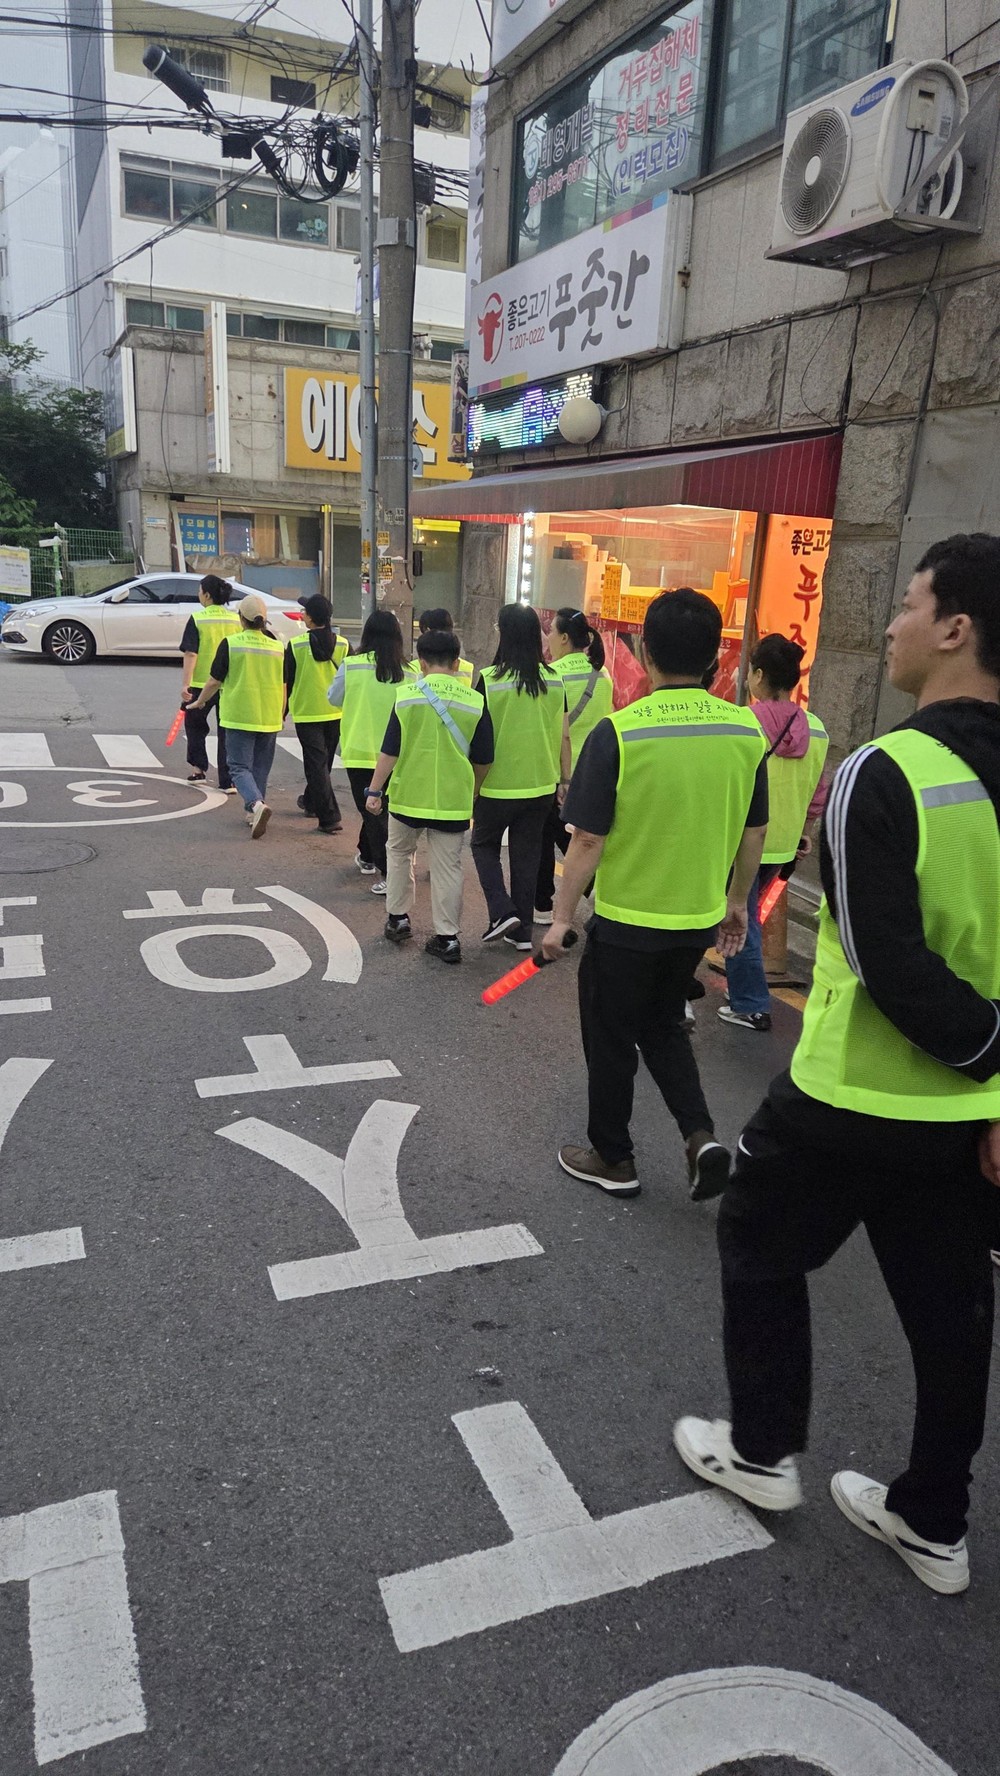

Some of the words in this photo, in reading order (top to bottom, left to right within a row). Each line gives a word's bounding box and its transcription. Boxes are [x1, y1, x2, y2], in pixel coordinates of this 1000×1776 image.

[617, 15, 700, 100] 거푸집해체
[856, 85, 891, 109] SAMSUNG
[611, 126, 690, 199] (인력모집)
[507, 284, 551, 332] 좋은고기
[549, 247, 651, 352] 푸줏간
[508, 326, 546, 351] T.207-0222
[658, 702, 690, 714] 밝히자
[694, 700, 712, 714] 길을
[716, 704, 740, 714] 지키자
